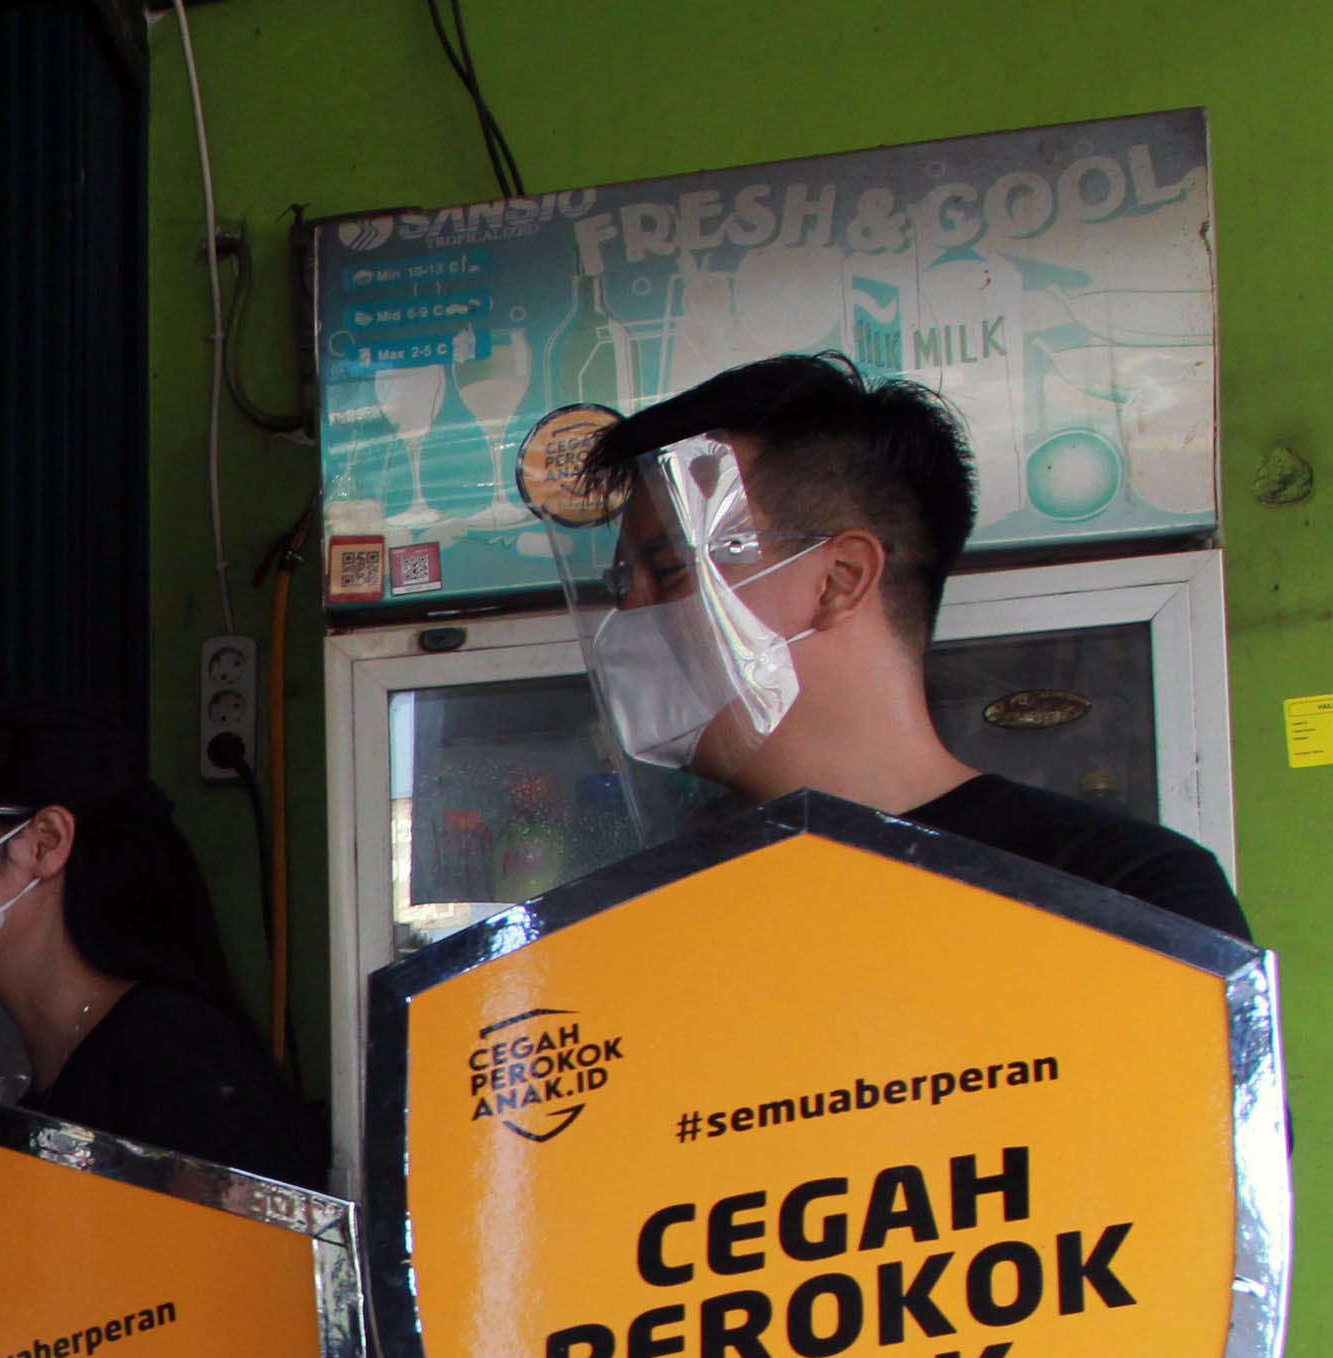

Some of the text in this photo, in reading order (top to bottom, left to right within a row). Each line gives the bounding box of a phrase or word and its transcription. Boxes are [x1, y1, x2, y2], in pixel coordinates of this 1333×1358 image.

[425, 222, 541, 249] TROPICALIZED
[574, 182, 837, 275] FRESH
[376, 268, 401, 281] Min
[376, 309, 402, 322] Mid
[913, 315, 1007, 369] MILK
[377, 348, 406, 361] Max
[468, 1023, 580, 1072] CEGAH
[469, 1037, 624, 1097] PEROKOK
[470, 1066, 608, 1122] ANAK.ID
[674, 1055, 1060, 1145] #semuaberperan
[636, 1146, 1030, 1289] CEGAH
